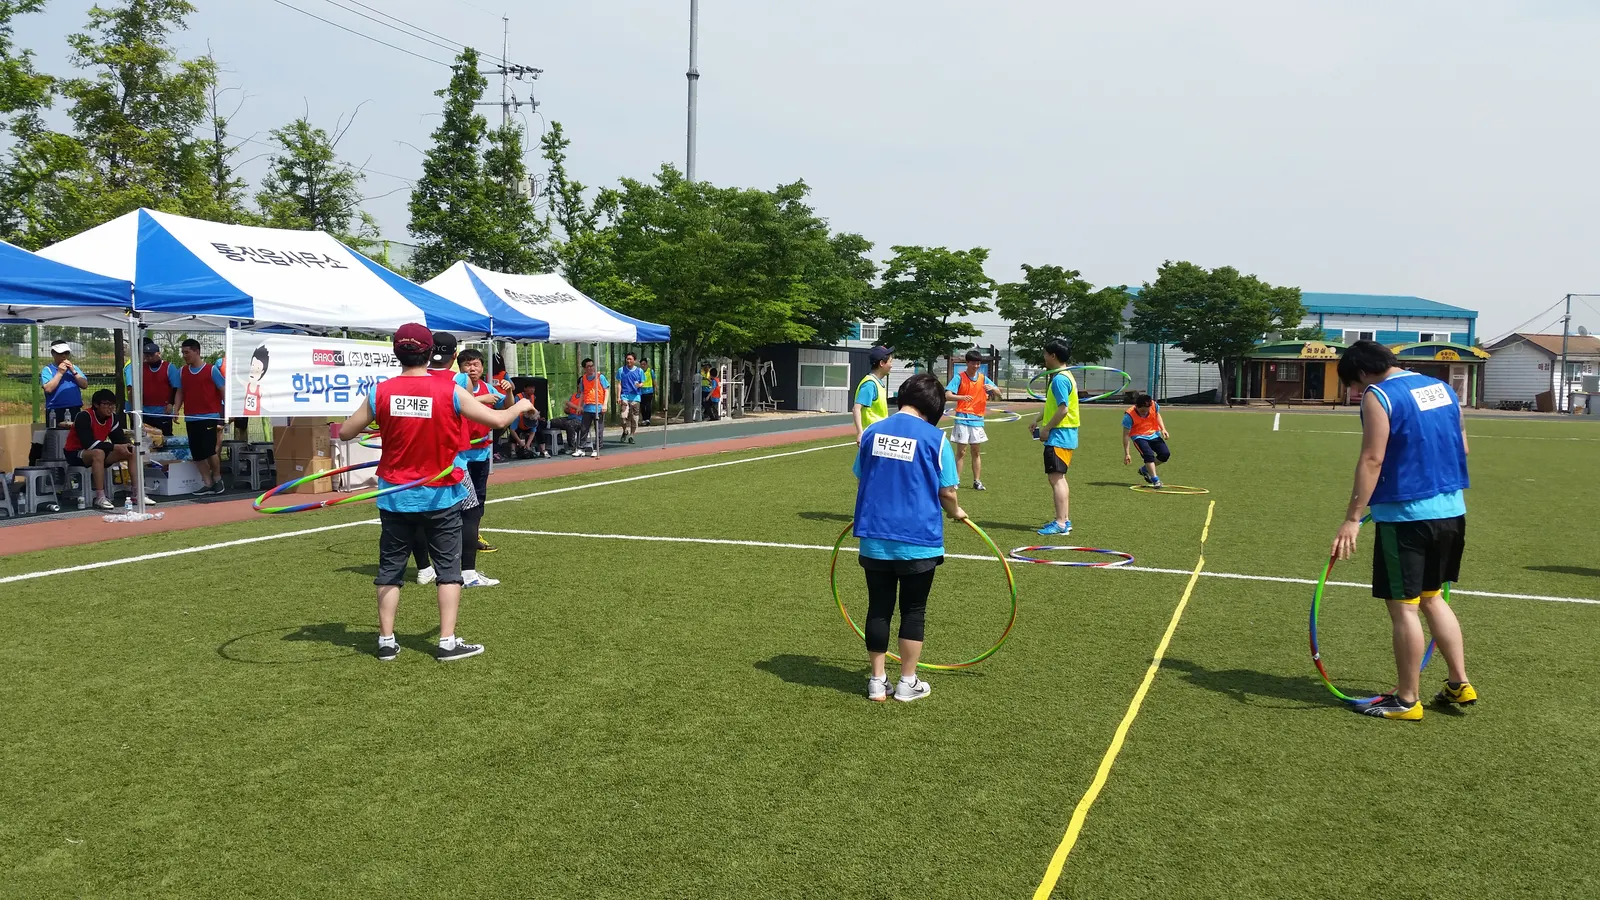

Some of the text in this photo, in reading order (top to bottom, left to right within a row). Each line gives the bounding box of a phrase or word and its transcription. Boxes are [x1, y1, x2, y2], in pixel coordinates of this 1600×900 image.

[210, 242, 349, 269] 통진읍사무소
[313, 351, 344, 363] BAROCO
[348, 351, 402, 367] (주)한국바로
[292, 373, 351, 402] 한마음
[1416, 386, 1445, 404] 김일상
[246, 398, 255, 408] 56
[395, 398, 429, 411] 임재윤
[878, 437, 912, 455] 박은선
